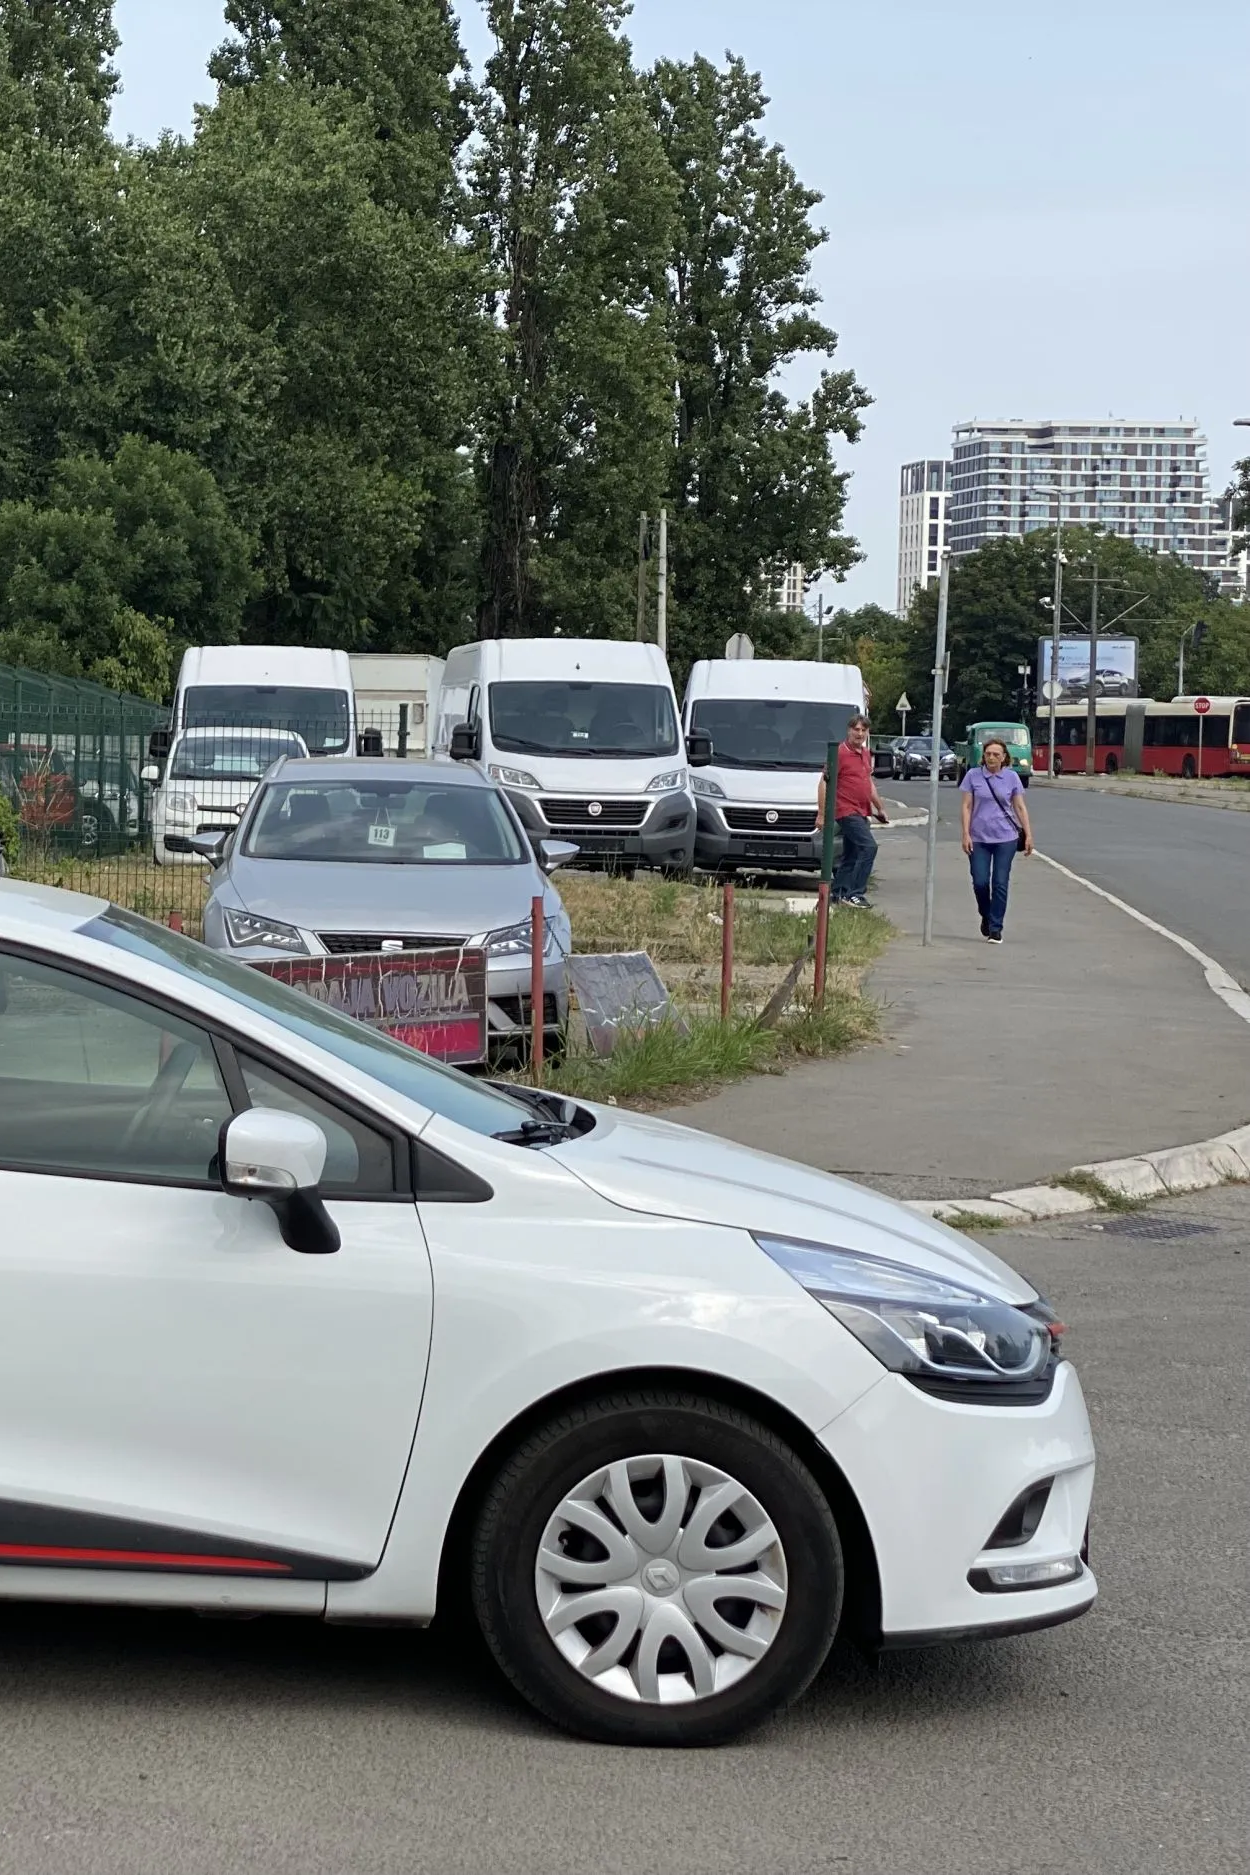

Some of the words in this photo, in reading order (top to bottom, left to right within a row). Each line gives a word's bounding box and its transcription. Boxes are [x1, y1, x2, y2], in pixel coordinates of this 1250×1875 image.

[1195, 702, 1209, 710] STOP
[374, 828, 390, 840] 113
[383, 972, 469, 1011] VOZILA
